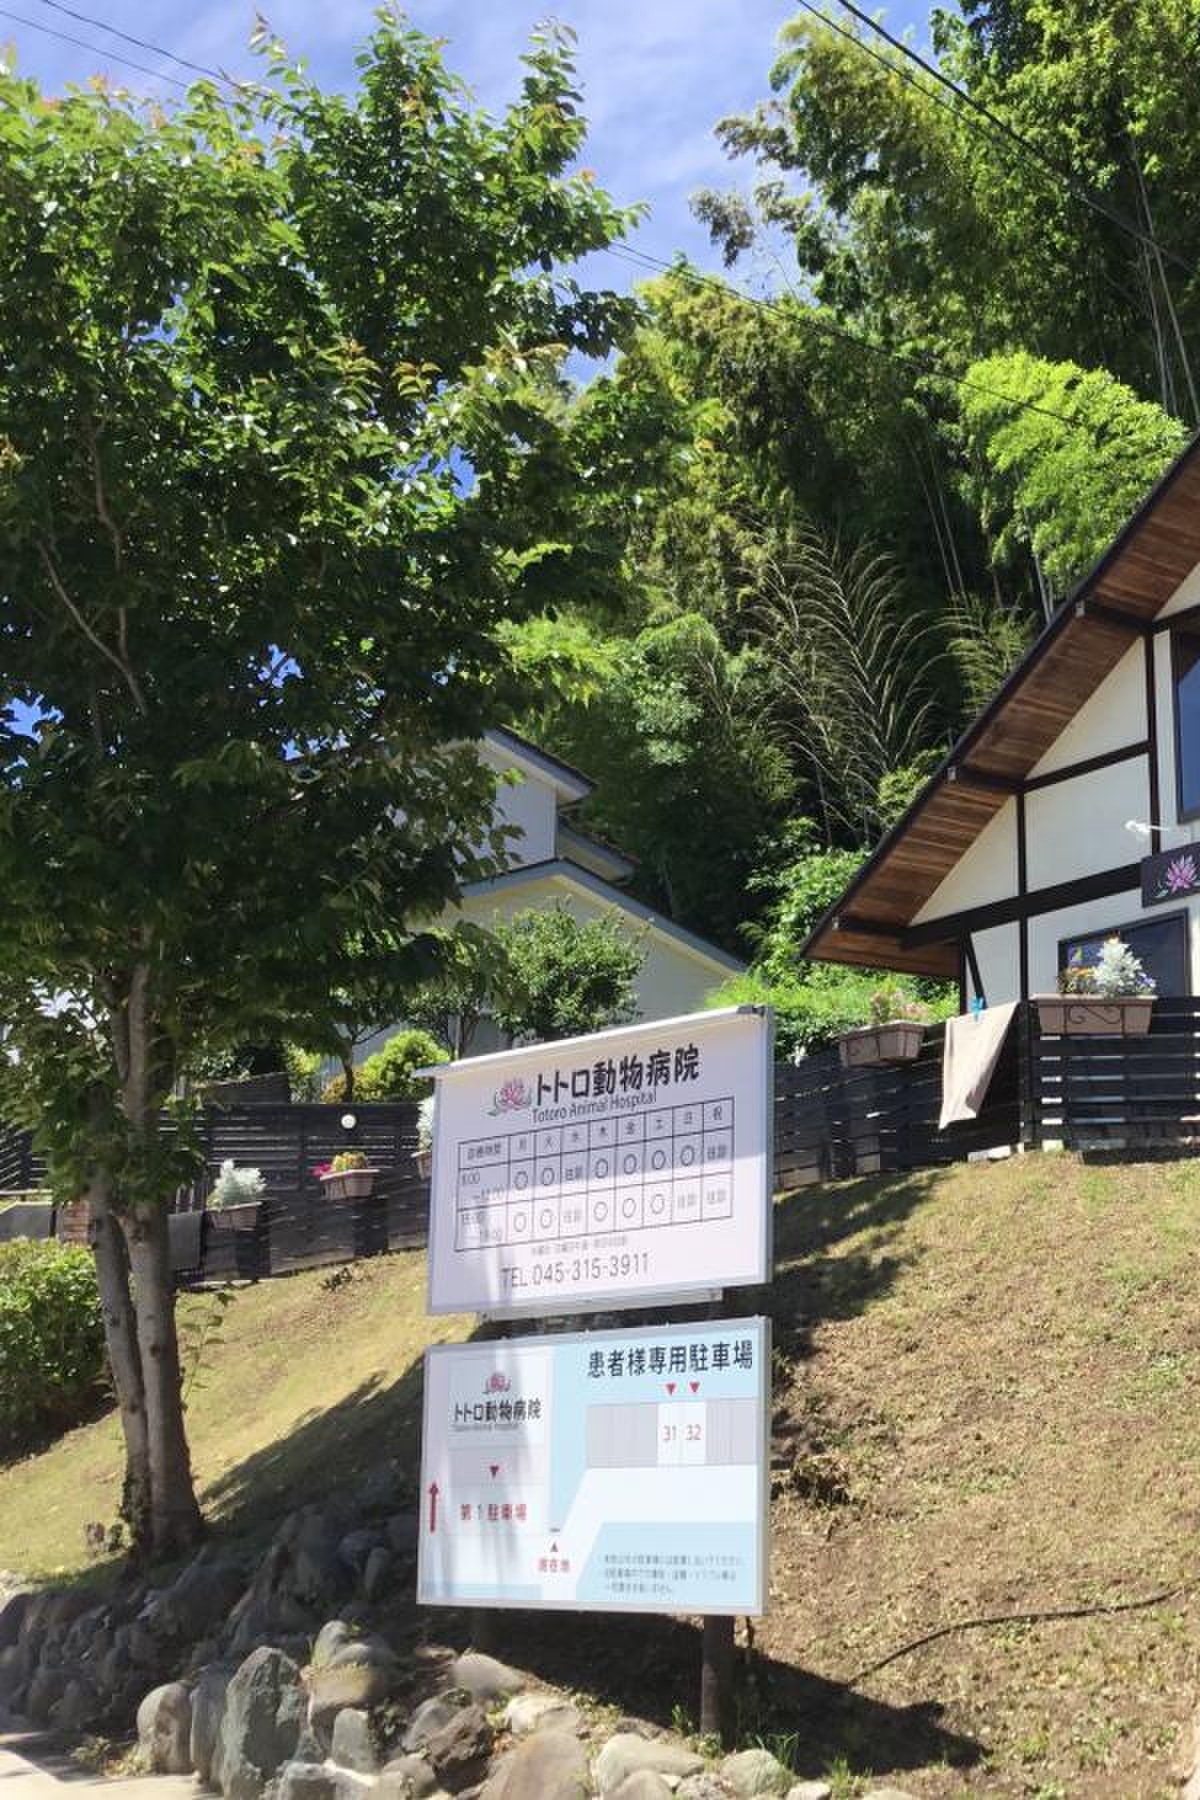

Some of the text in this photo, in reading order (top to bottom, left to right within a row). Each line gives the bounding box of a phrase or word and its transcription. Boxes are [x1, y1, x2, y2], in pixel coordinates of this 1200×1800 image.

[536, 1043, 700, 1107] トトロ動物病院
[569, 1099, 606, 1117] Animal
[609, 1090, 657, 1112] Hospital
[501, 1252, 650, 1289] TEL 045-315-3911
[587, 1339, 753, 1378] 患者様専用駐車場
[454, 1397, 543, 1423] トトロ動物病院
[662, 1423, 702, 1441] 31 32
